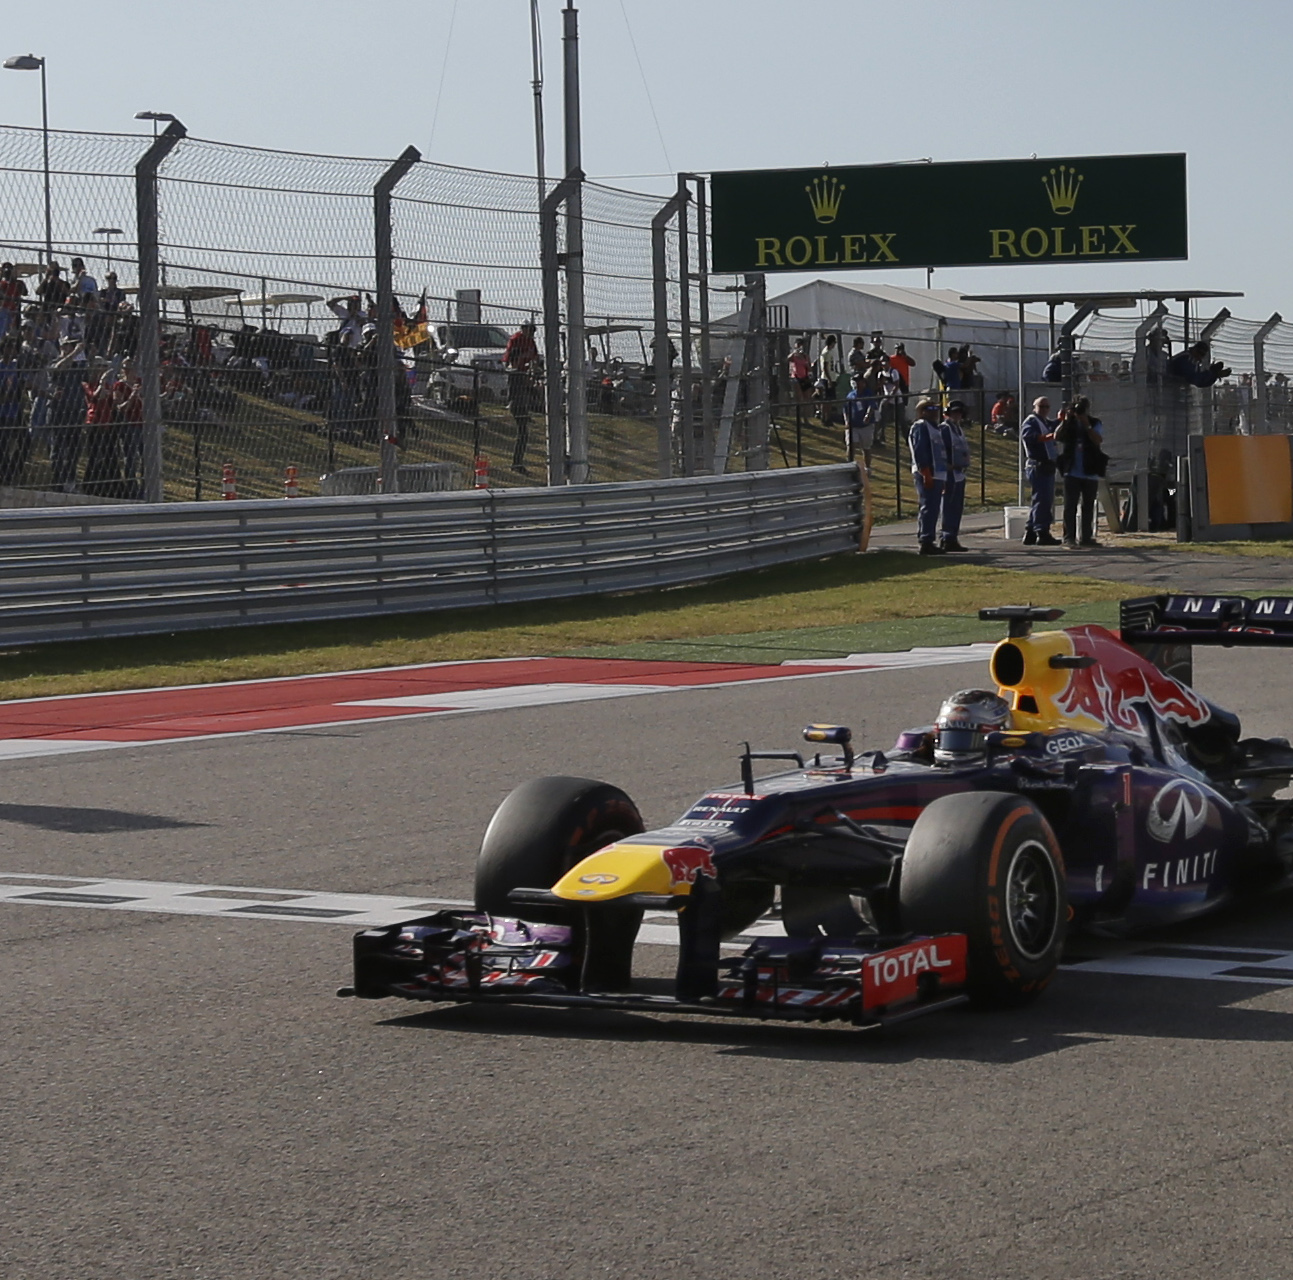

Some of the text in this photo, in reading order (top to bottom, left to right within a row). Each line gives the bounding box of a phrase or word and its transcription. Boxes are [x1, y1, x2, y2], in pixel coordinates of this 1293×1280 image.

[754, 224, 1140, 266] ROLEX ROLEX
[1046, 736, 1086, 755] GEOX
[678, 820, 735, 828] PIRELLI
[692, 806, 750, 814] RENAULT
[1095, 849, 1217, 892] IFINITI
[868, 945, 952, 986] TOTAL
